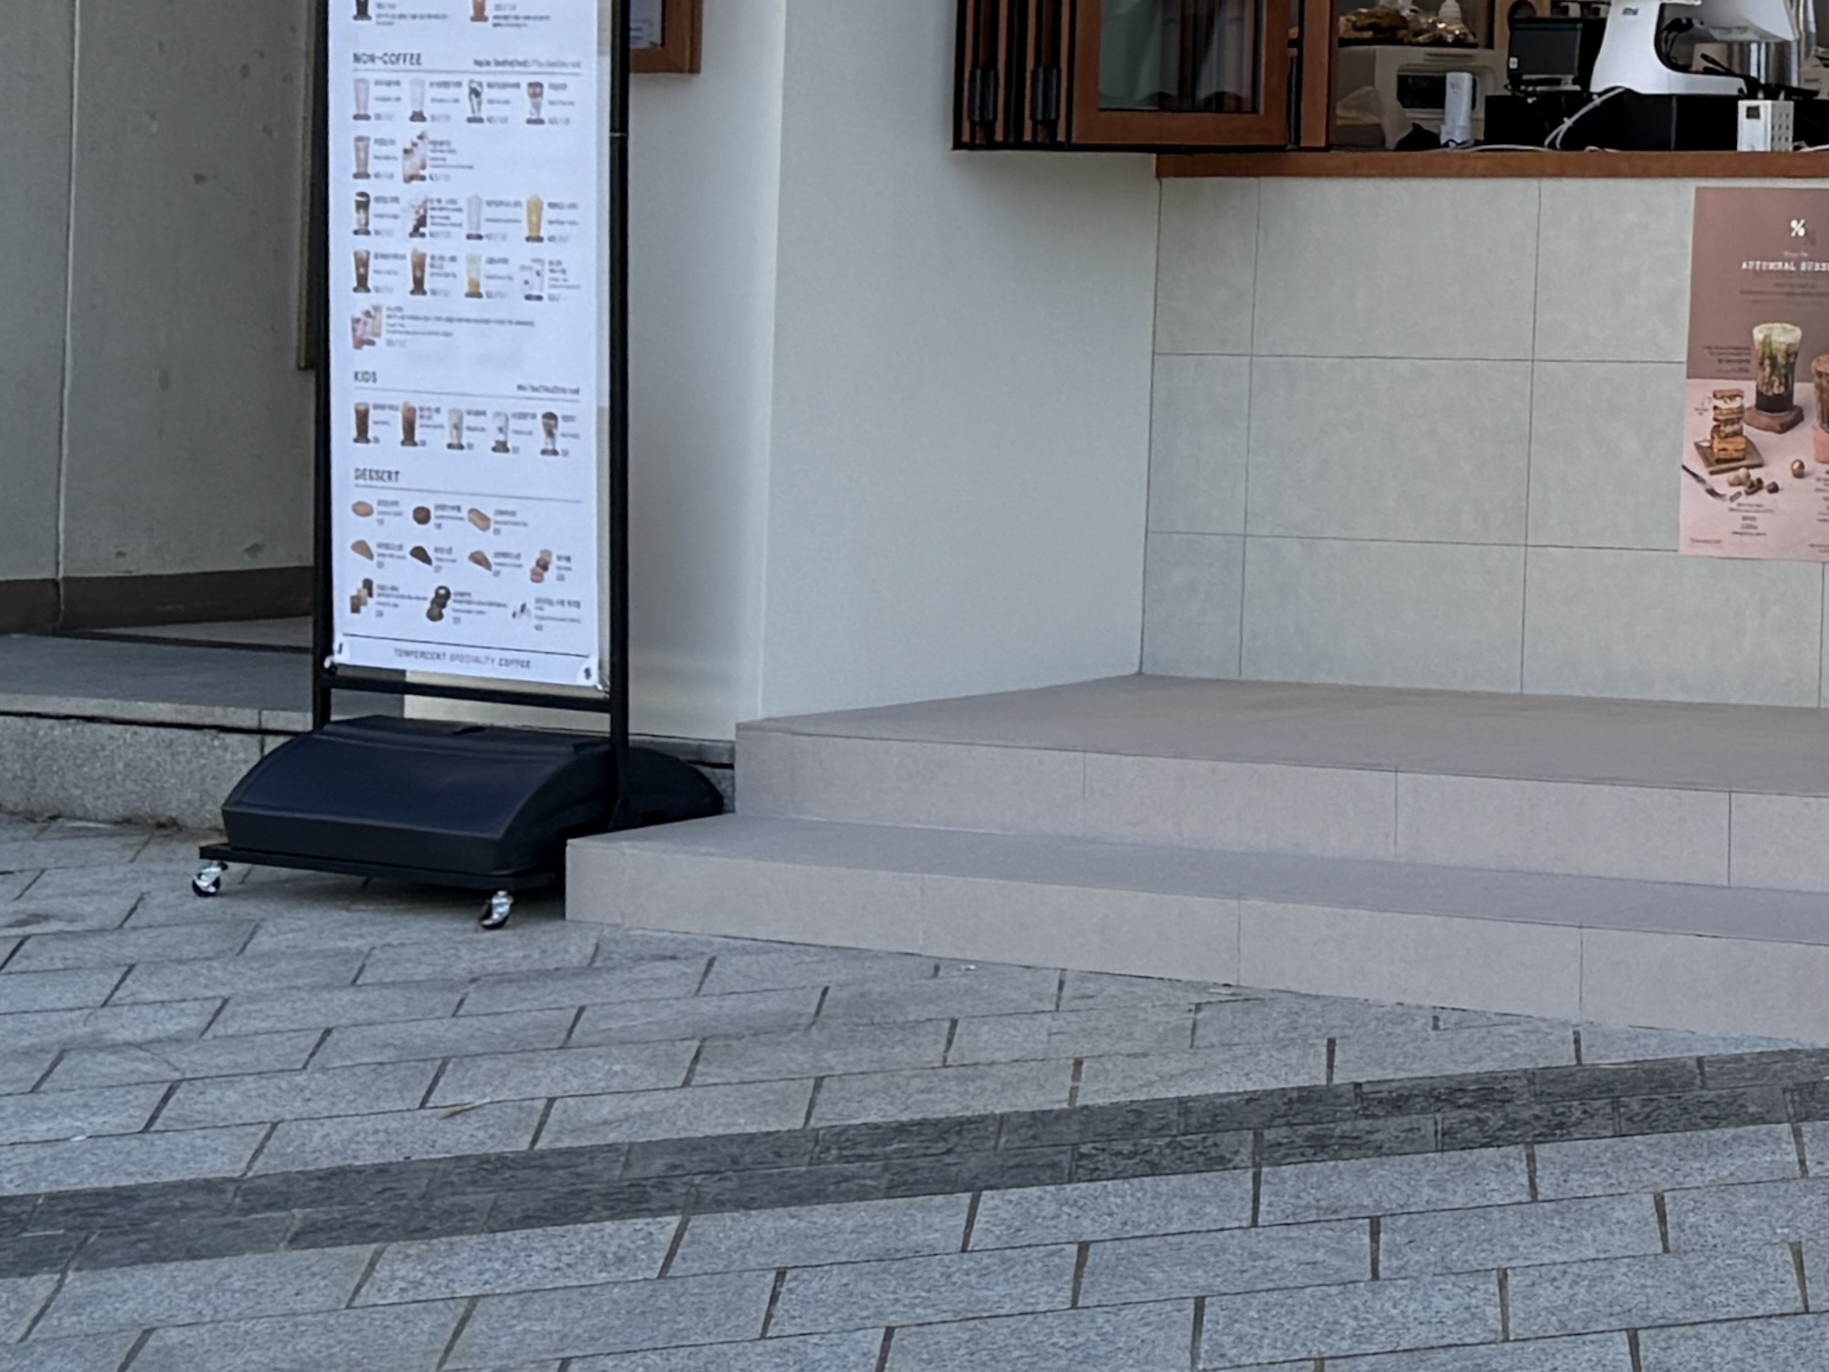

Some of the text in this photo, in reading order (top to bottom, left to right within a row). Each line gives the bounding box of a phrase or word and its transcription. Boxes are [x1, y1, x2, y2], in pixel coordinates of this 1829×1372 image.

[353, 52, 422, 66] NON-COFFEE
[353, 370, 378, 384] KIDS
[353, 468, 401, 484] DESSERT
